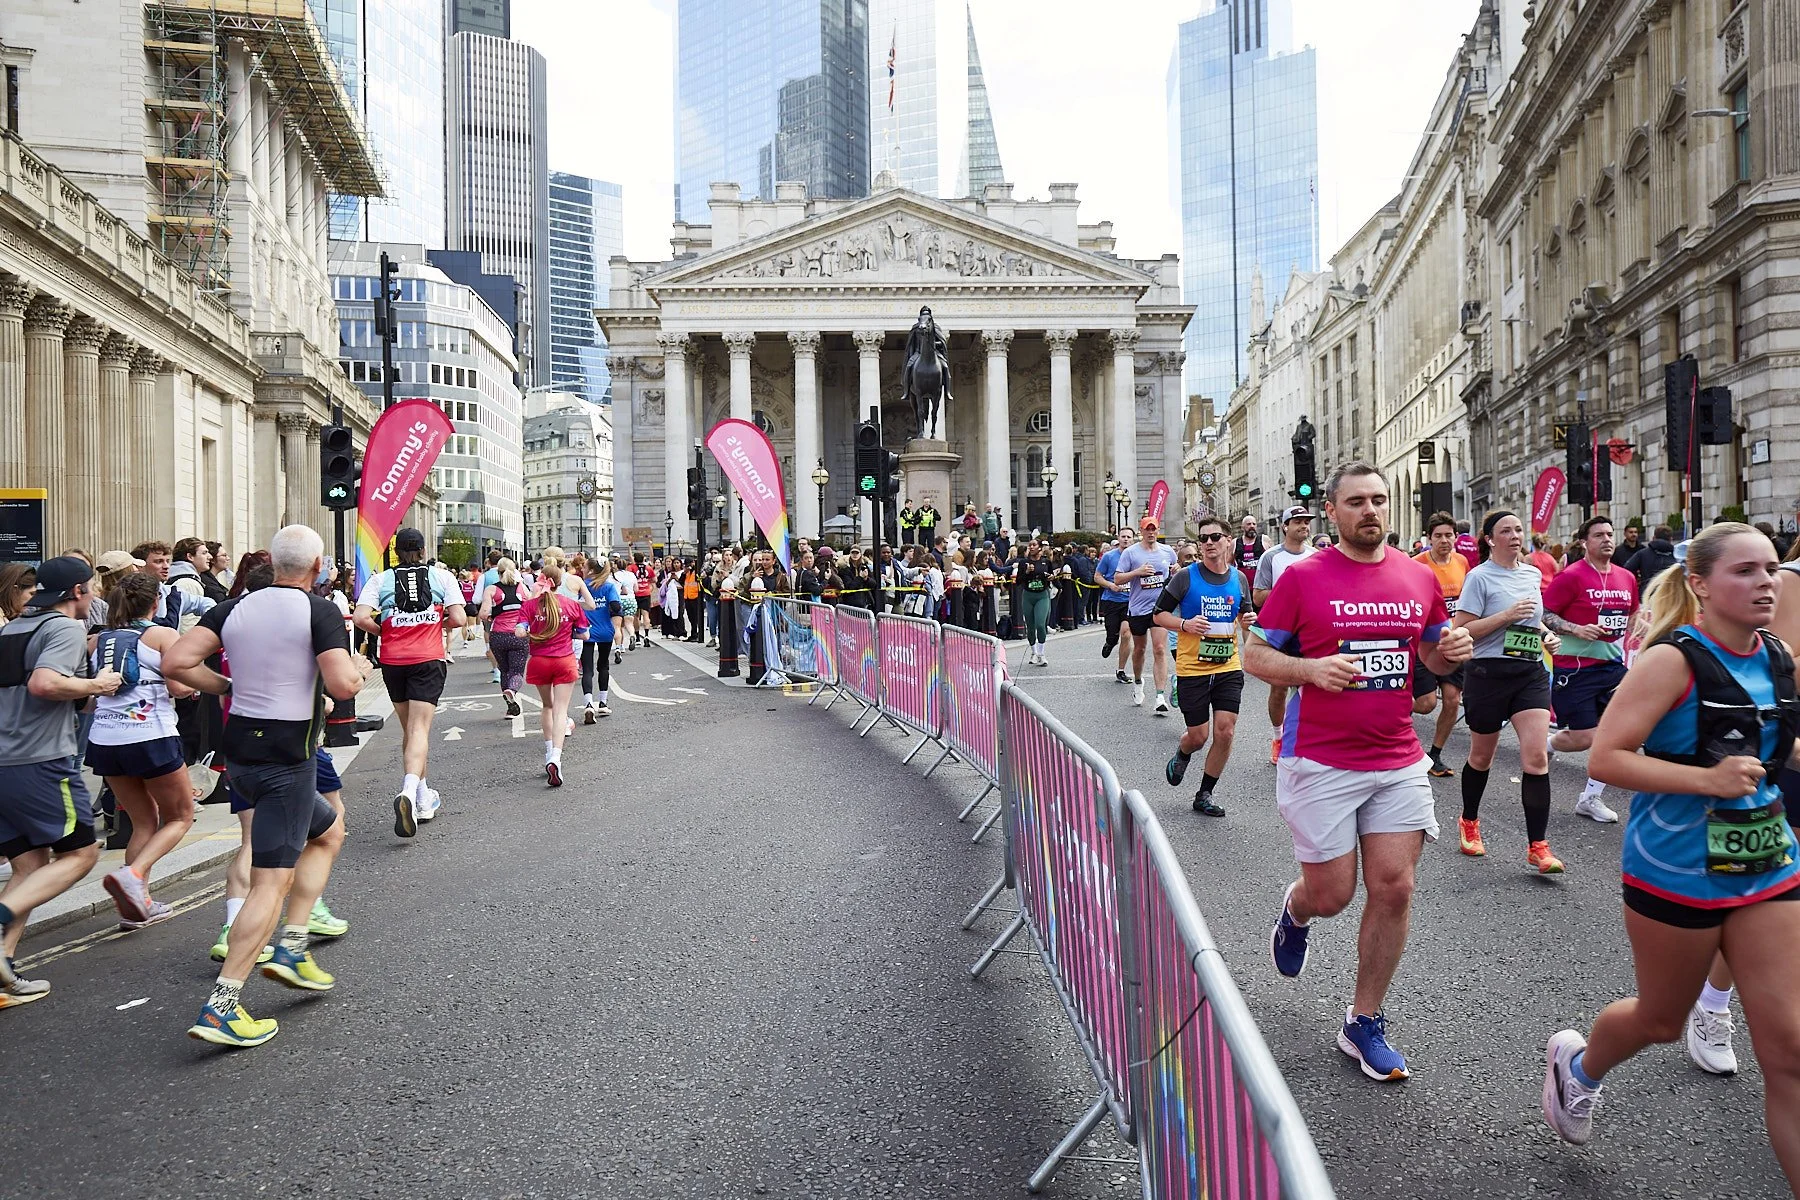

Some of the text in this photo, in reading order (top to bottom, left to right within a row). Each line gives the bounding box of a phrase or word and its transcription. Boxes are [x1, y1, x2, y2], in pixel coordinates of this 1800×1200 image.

[371, 421, 428, 503] Tommy's
[1536, 477, 1557, 521] Tommy's
[1201, 595, 1225, 603] North
[1586, 588, 1632, 601] Tommy's
[1201, 602, 1232, 610] London
[1329, 599, 1423, 620] Tommy's
[1202, 609, 1232, 618] Hospice
[1345, 620, 1378, 628] pregnancy
[1390, 620, 1406, 628] baby
[1205, 643, 1230, 655] 7781
[1359, 653, 1405, 673] 1533
